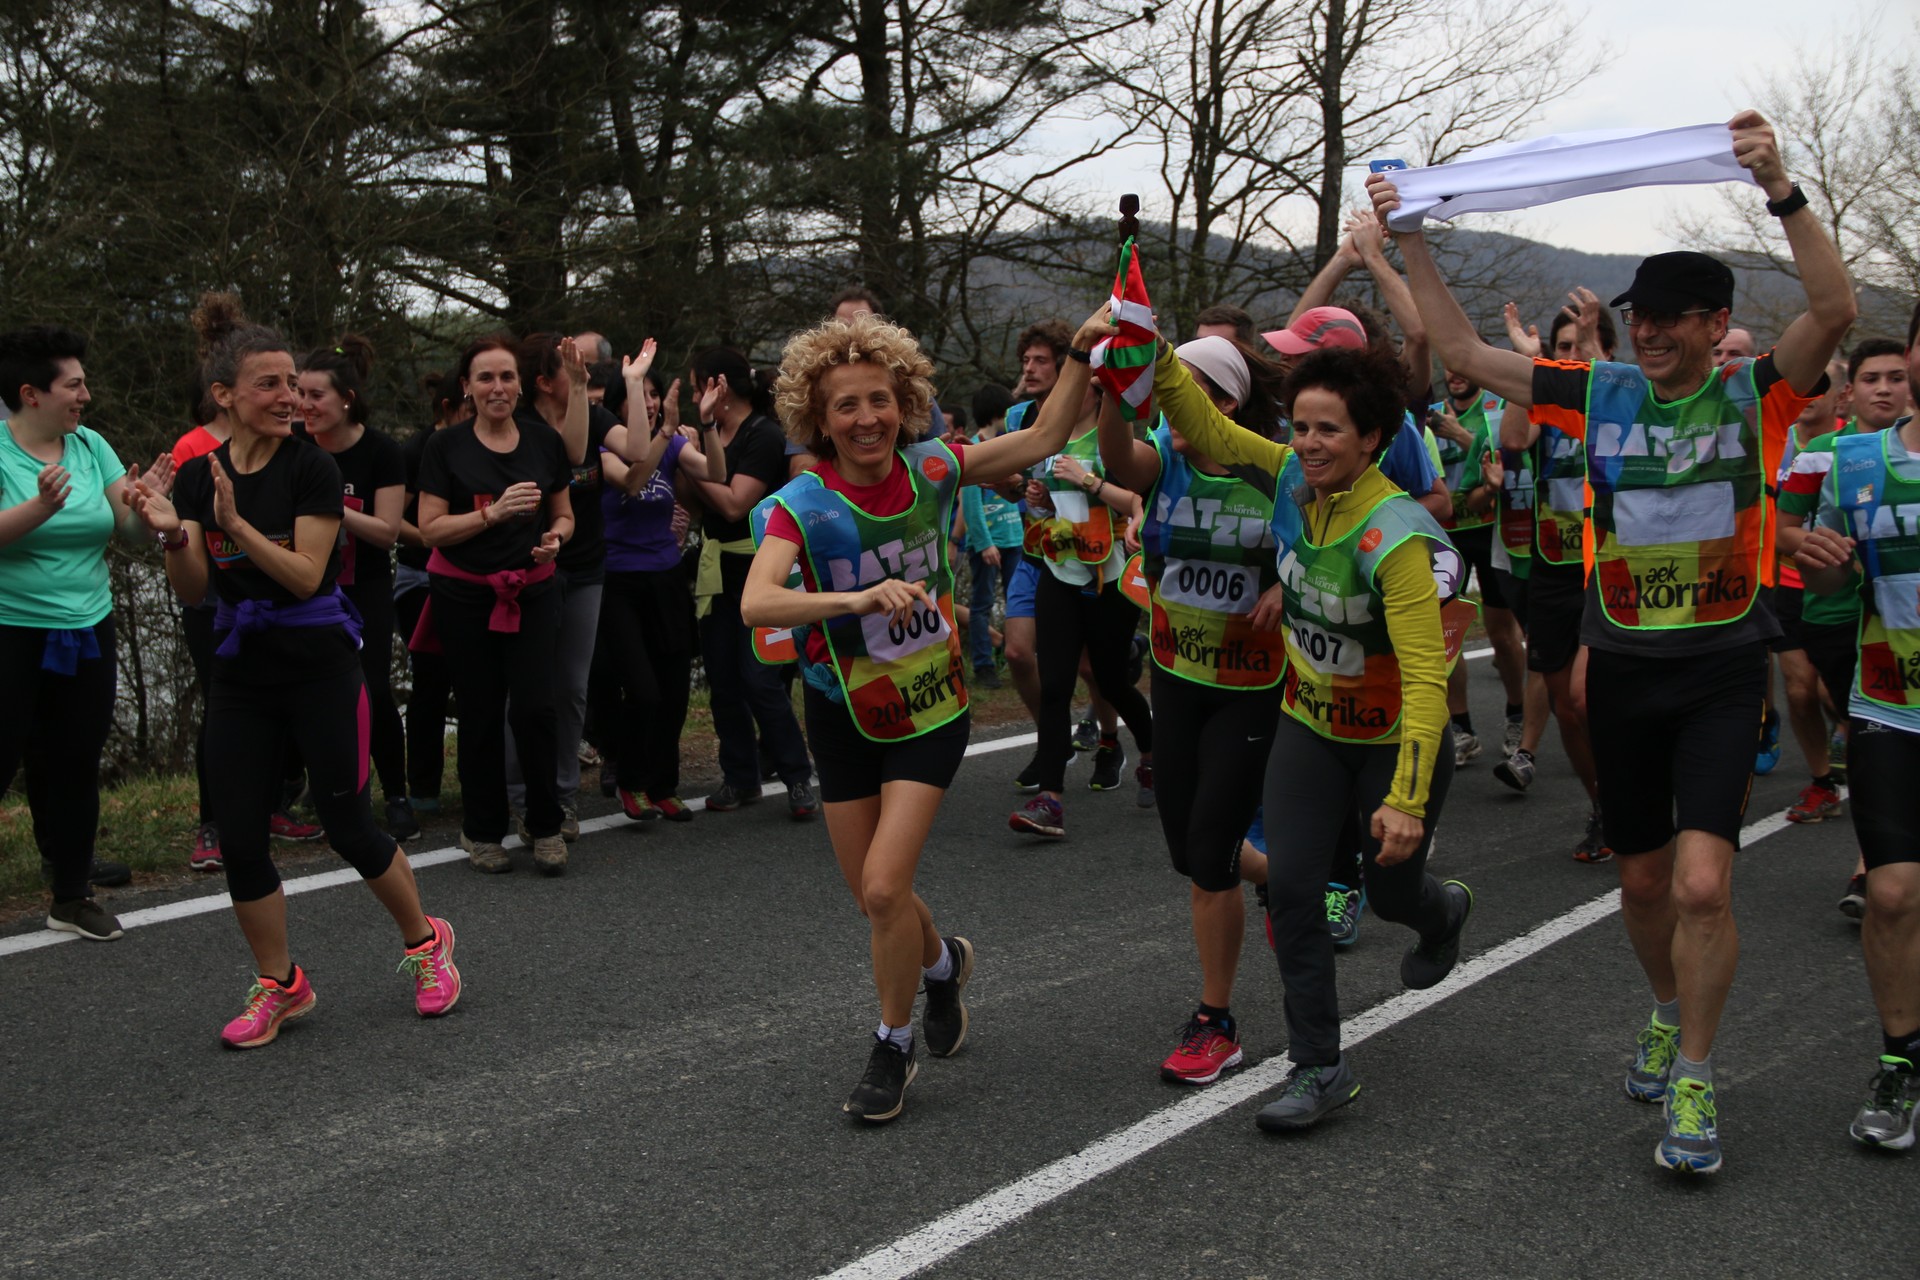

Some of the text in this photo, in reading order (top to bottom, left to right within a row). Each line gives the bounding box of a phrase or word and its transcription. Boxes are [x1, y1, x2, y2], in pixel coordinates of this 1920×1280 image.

[1612, 375, 1637, 389] eitb
[820, 509, 840, 523] eitb
[1178, 566, 1245, 601] 0006
[1645, 559, 1679, 584] aek
[1632, 569, 1748, 609] korrika
[1180, 624, 1208, 644] aek
[1171, 627, 1271, 672] korrika
[912, 662, 938, 691] aek
